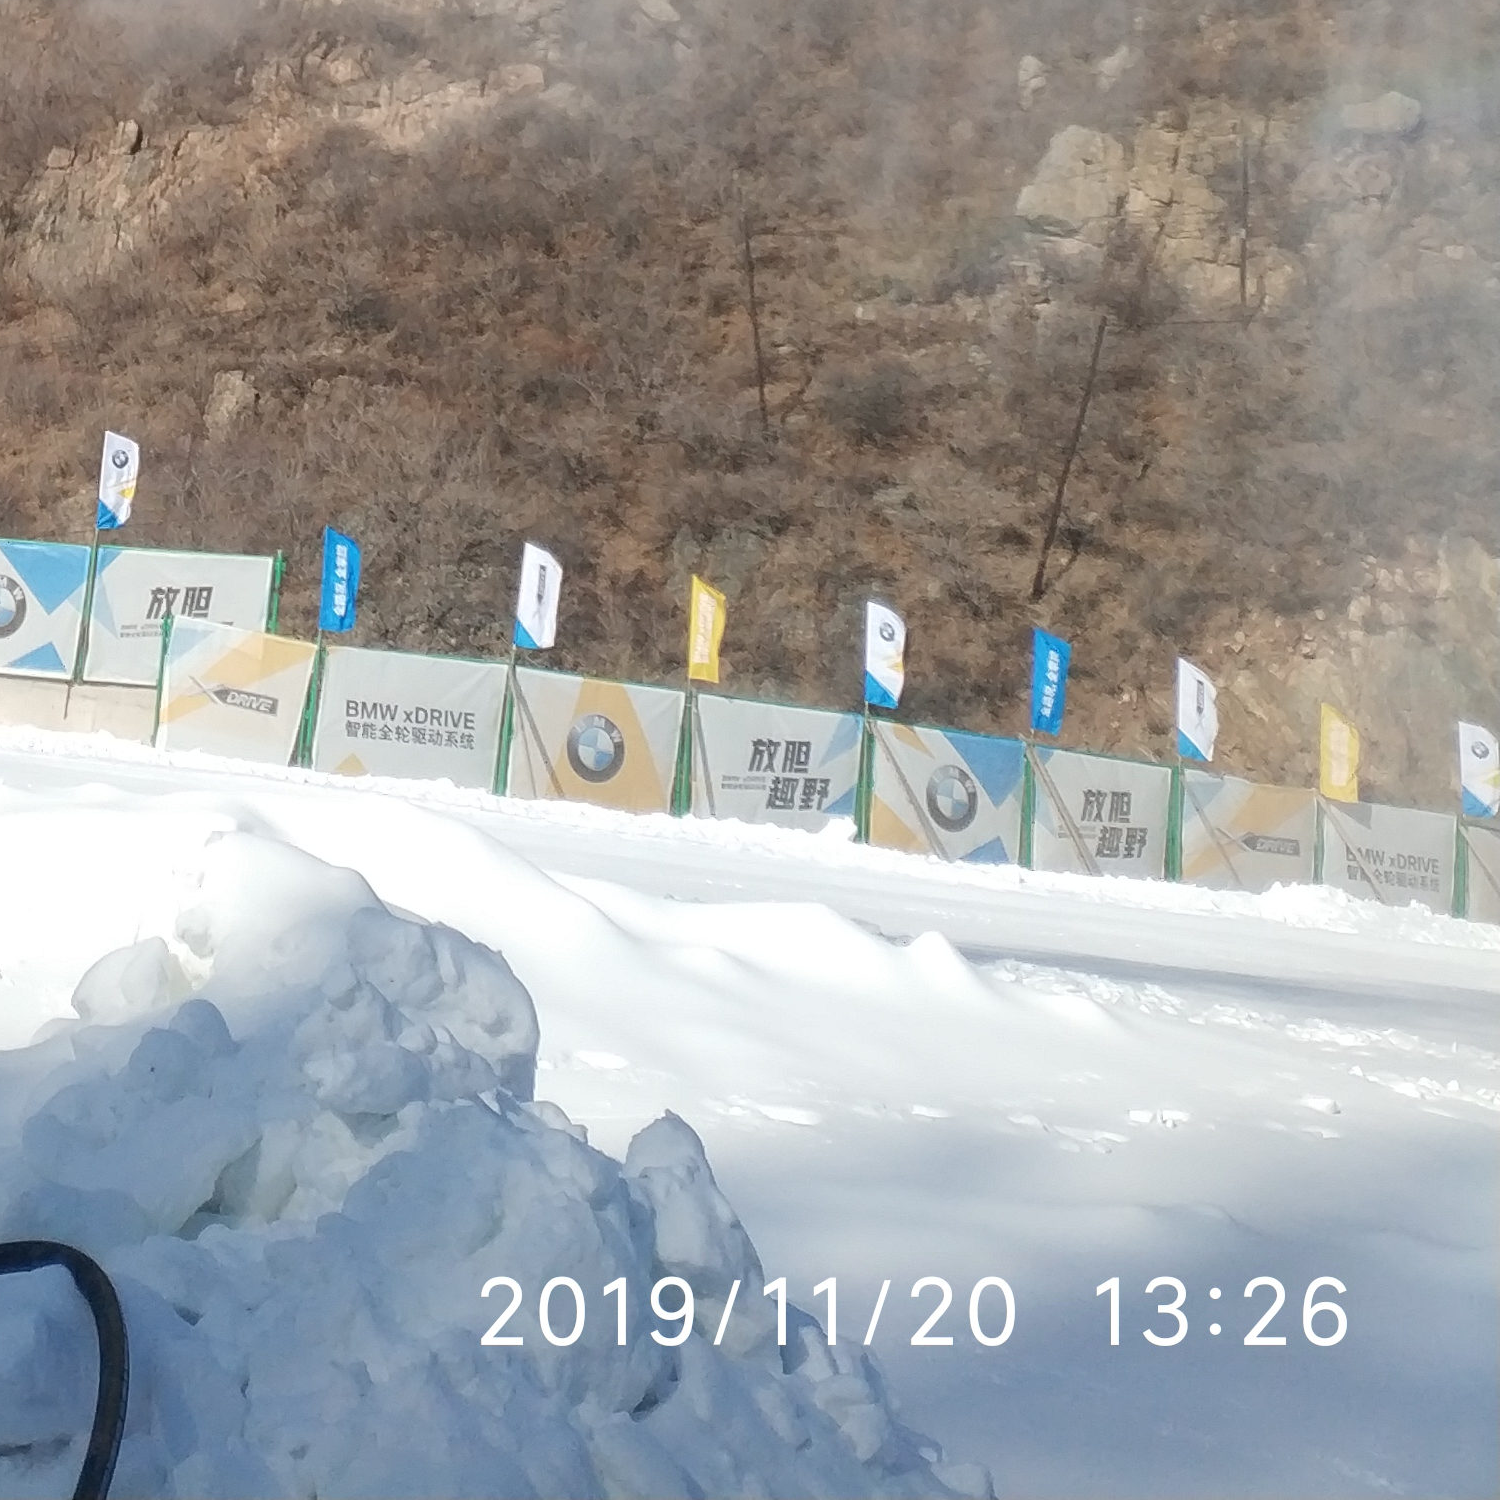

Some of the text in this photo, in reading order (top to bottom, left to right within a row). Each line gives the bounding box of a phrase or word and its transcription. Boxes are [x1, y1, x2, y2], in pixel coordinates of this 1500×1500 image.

[145, 586, 214, 620] 放胆
[346, 700, 476, 731] BMW xDRIVE
[345, 720, 475, 750] 智能全轮驱动系统
[747, 738, 812, 773] 放胆
[1080, 789, 1132, 823] 放胆
[1389, 852, 1440, 875] xDRIVE
